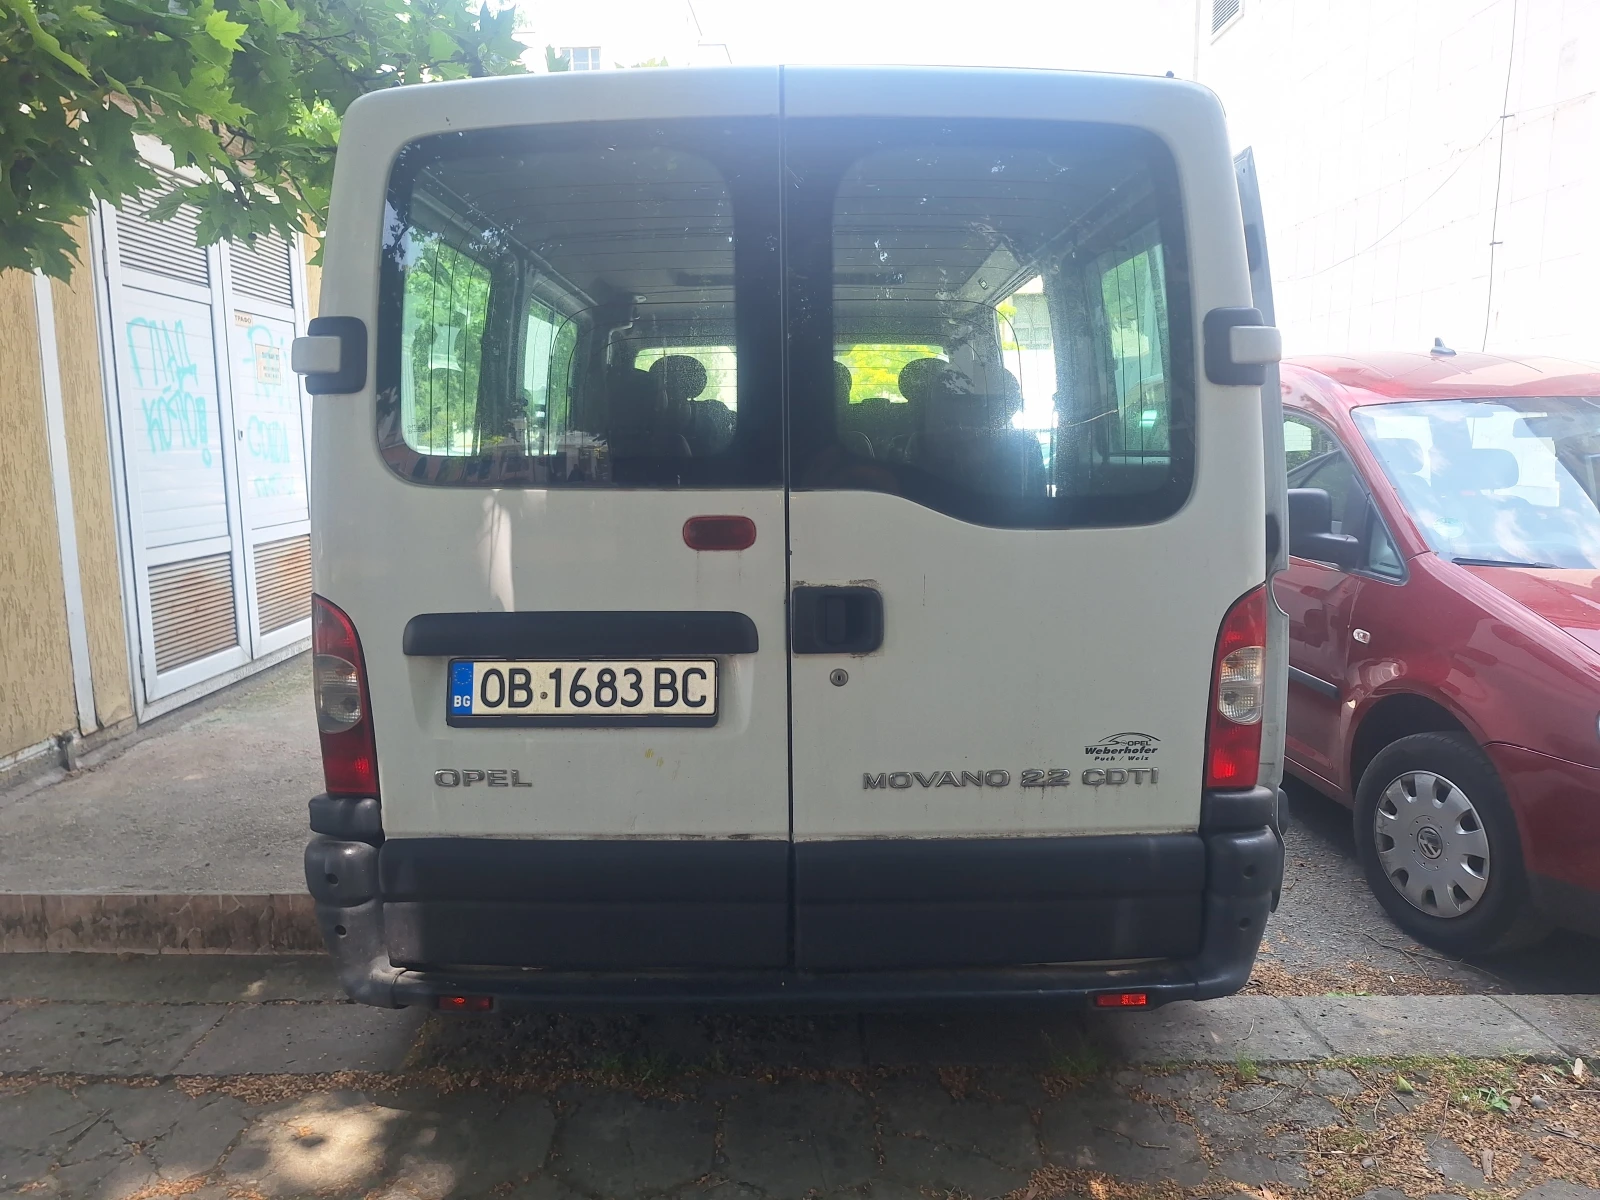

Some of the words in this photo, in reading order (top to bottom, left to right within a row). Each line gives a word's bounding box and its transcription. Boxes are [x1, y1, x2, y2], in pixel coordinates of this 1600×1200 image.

[234, 314, 252, 324] ТРАФО
[549, 668, 643, 708] 1683
[453, 695, 471, 707] BG
[1084, 746, 1158, 755] Weberhofer
[434, 768, 533, 788] OPEL
[862, 769, 1011, 789] MOVANO
[1081, 766, 1159, 787] CDTI
